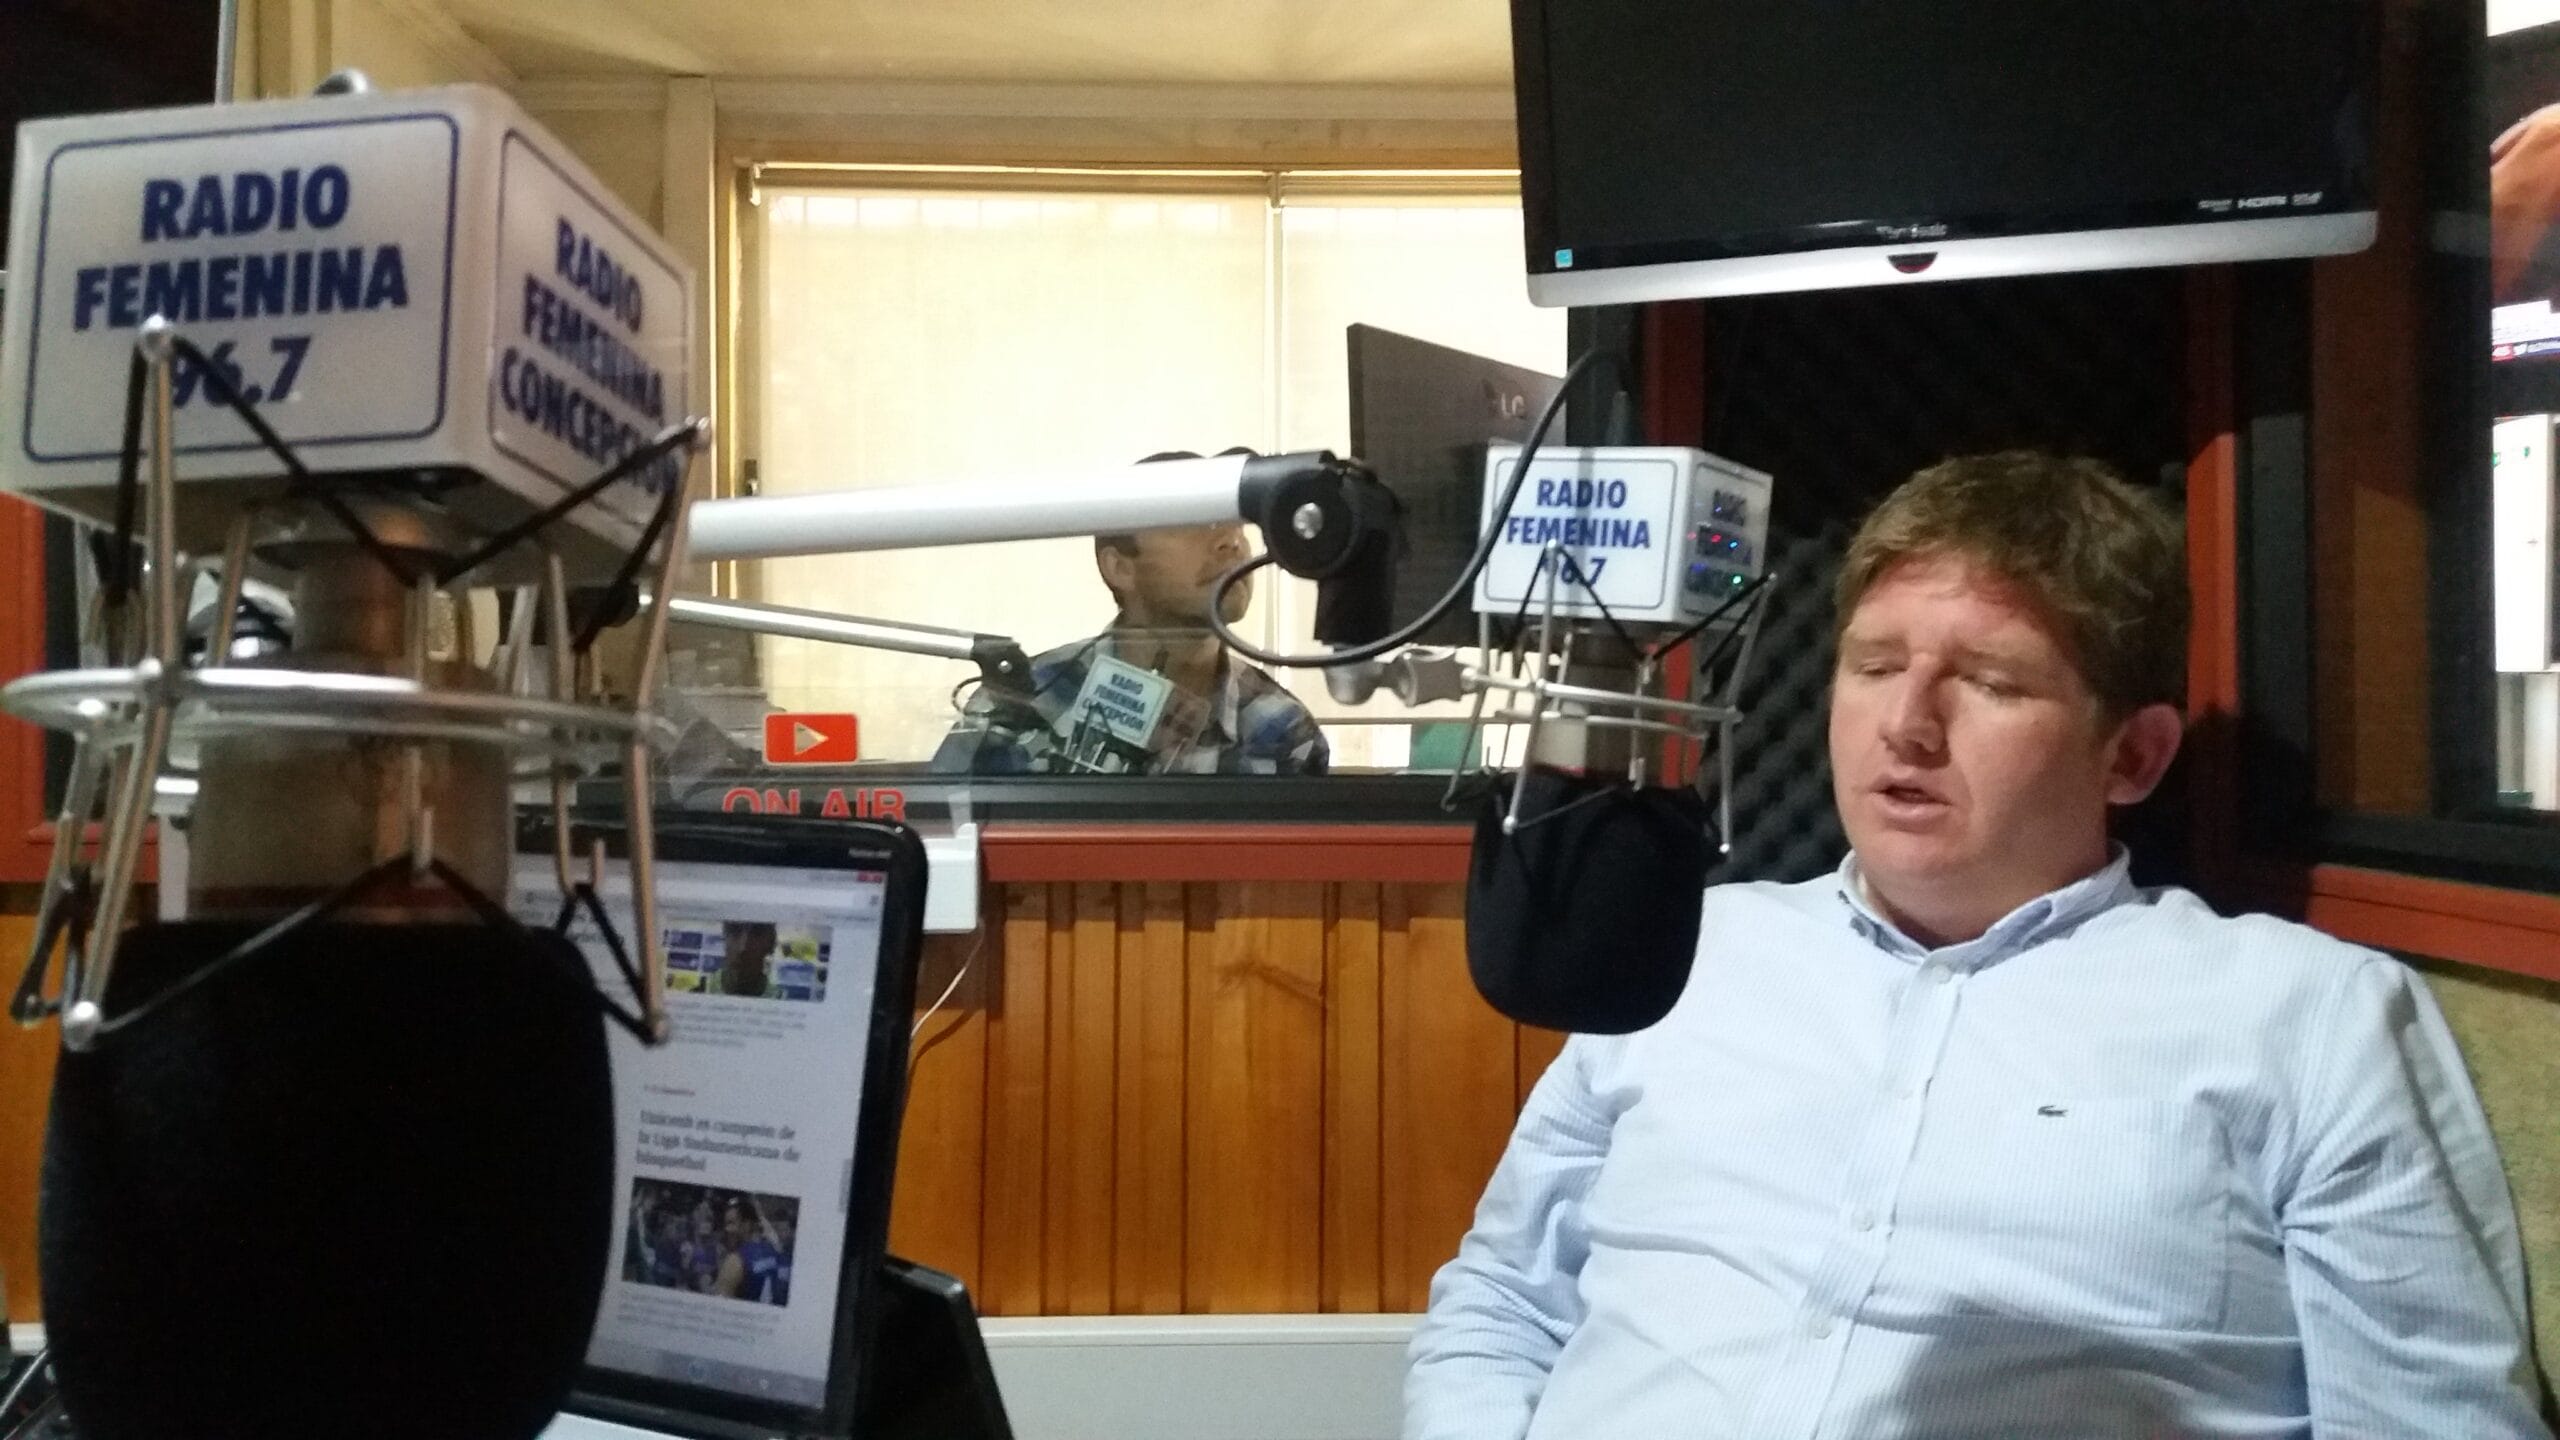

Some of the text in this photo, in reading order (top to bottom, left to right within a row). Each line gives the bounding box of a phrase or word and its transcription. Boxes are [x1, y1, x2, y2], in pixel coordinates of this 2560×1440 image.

[141, 164, 350, 243] RADIO
[73, 245, 408, 332] FEMENINA
[557, 215, 642, 334] RADIO
[523, 272, 664, 422] FEMENINA
[500, 347, 679, 498] CONCEPCON
[1537, 478, 1626, 509] RADIO
[1507, 516, 1650, 549] FEMENINA
[1111, 673, 1144, 695] RADIO
[1083, 698, 1145, 731] CCEPCION
[722, 786, 906, 822] ON AIR
